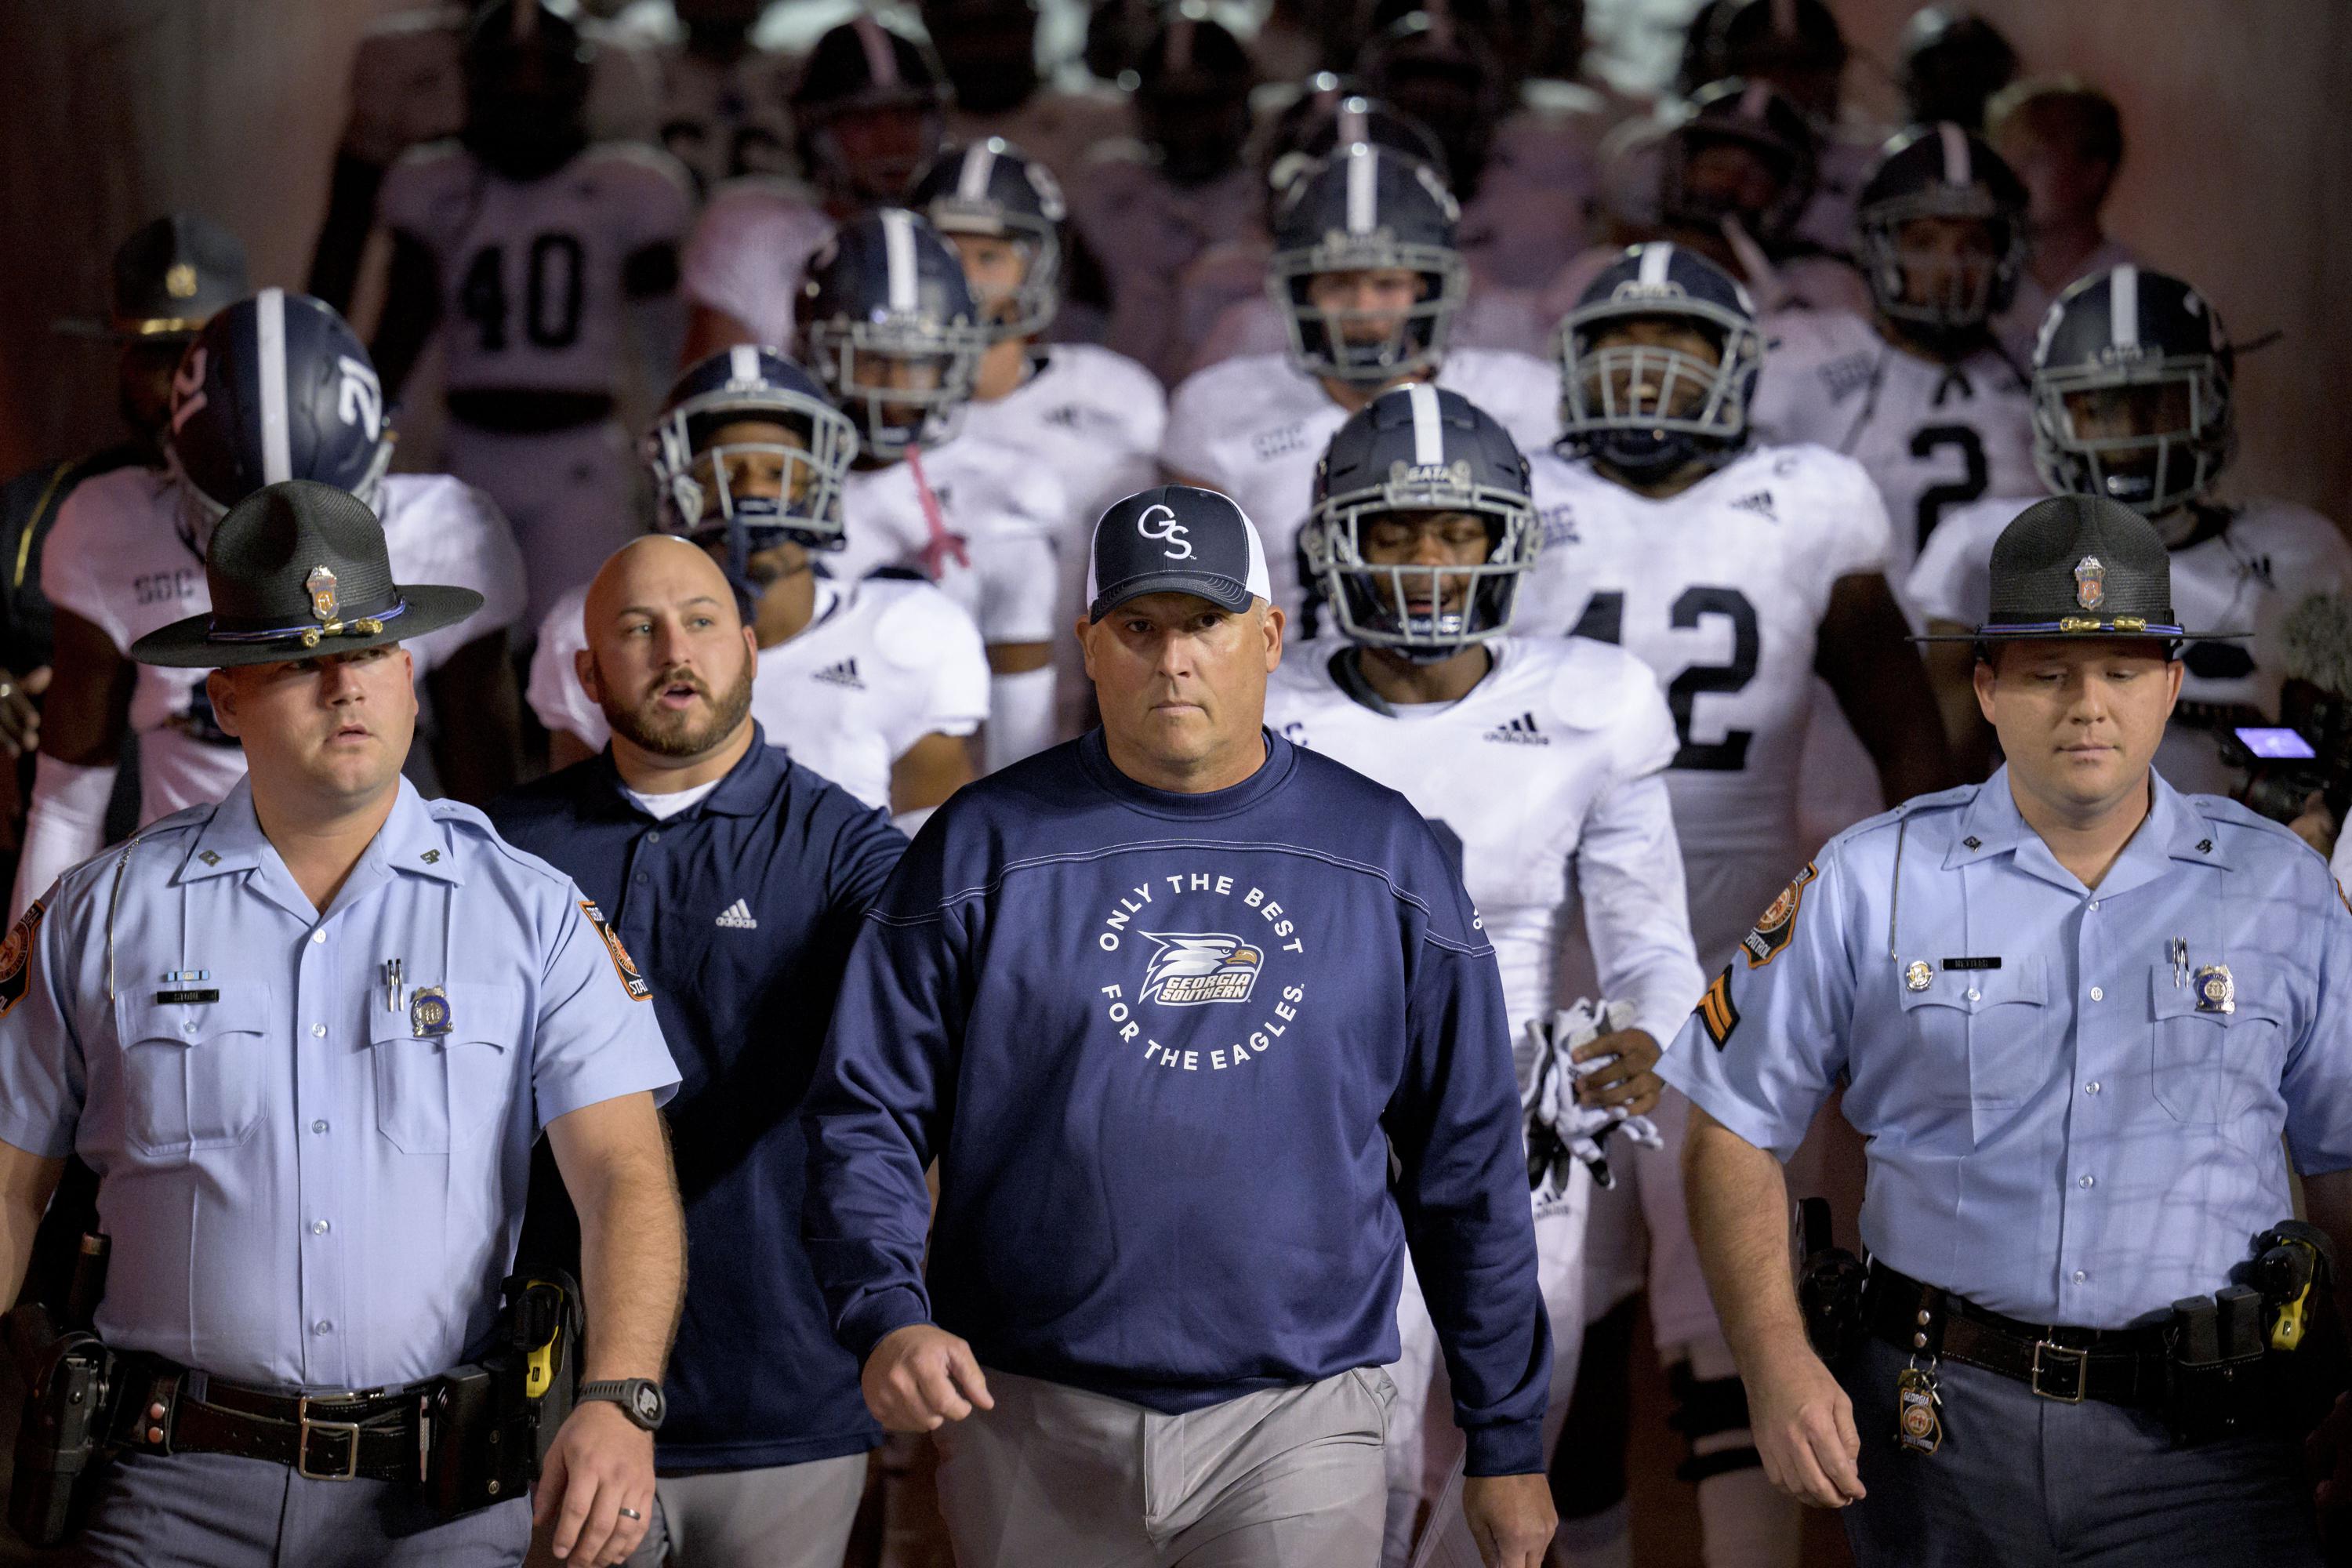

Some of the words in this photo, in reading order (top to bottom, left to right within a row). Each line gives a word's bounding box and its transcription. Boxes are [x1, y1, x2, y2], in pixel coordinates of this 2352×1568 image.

[463, 234, 585, 350] 40
[1138, 504, 1192, 560] GS
[715, 916, 757, 930] adidas
[1099, 883, 1152, 951] ONLY
[1167, 873, 1233, 895] THE
[1243, 887, 1303, 953] BEST
[1160, 985, 1247, 1001] SOUTHERN
[1166, 974, 1251, 989] GEORGIA
[1102, 984, 1139, 1043] FOR
[1144, 1040, 1198, 1070] THE
[1210, 985, 1303, 1070] EAGLES
[1904, 1392, 1929, 1406] GEORGIA
